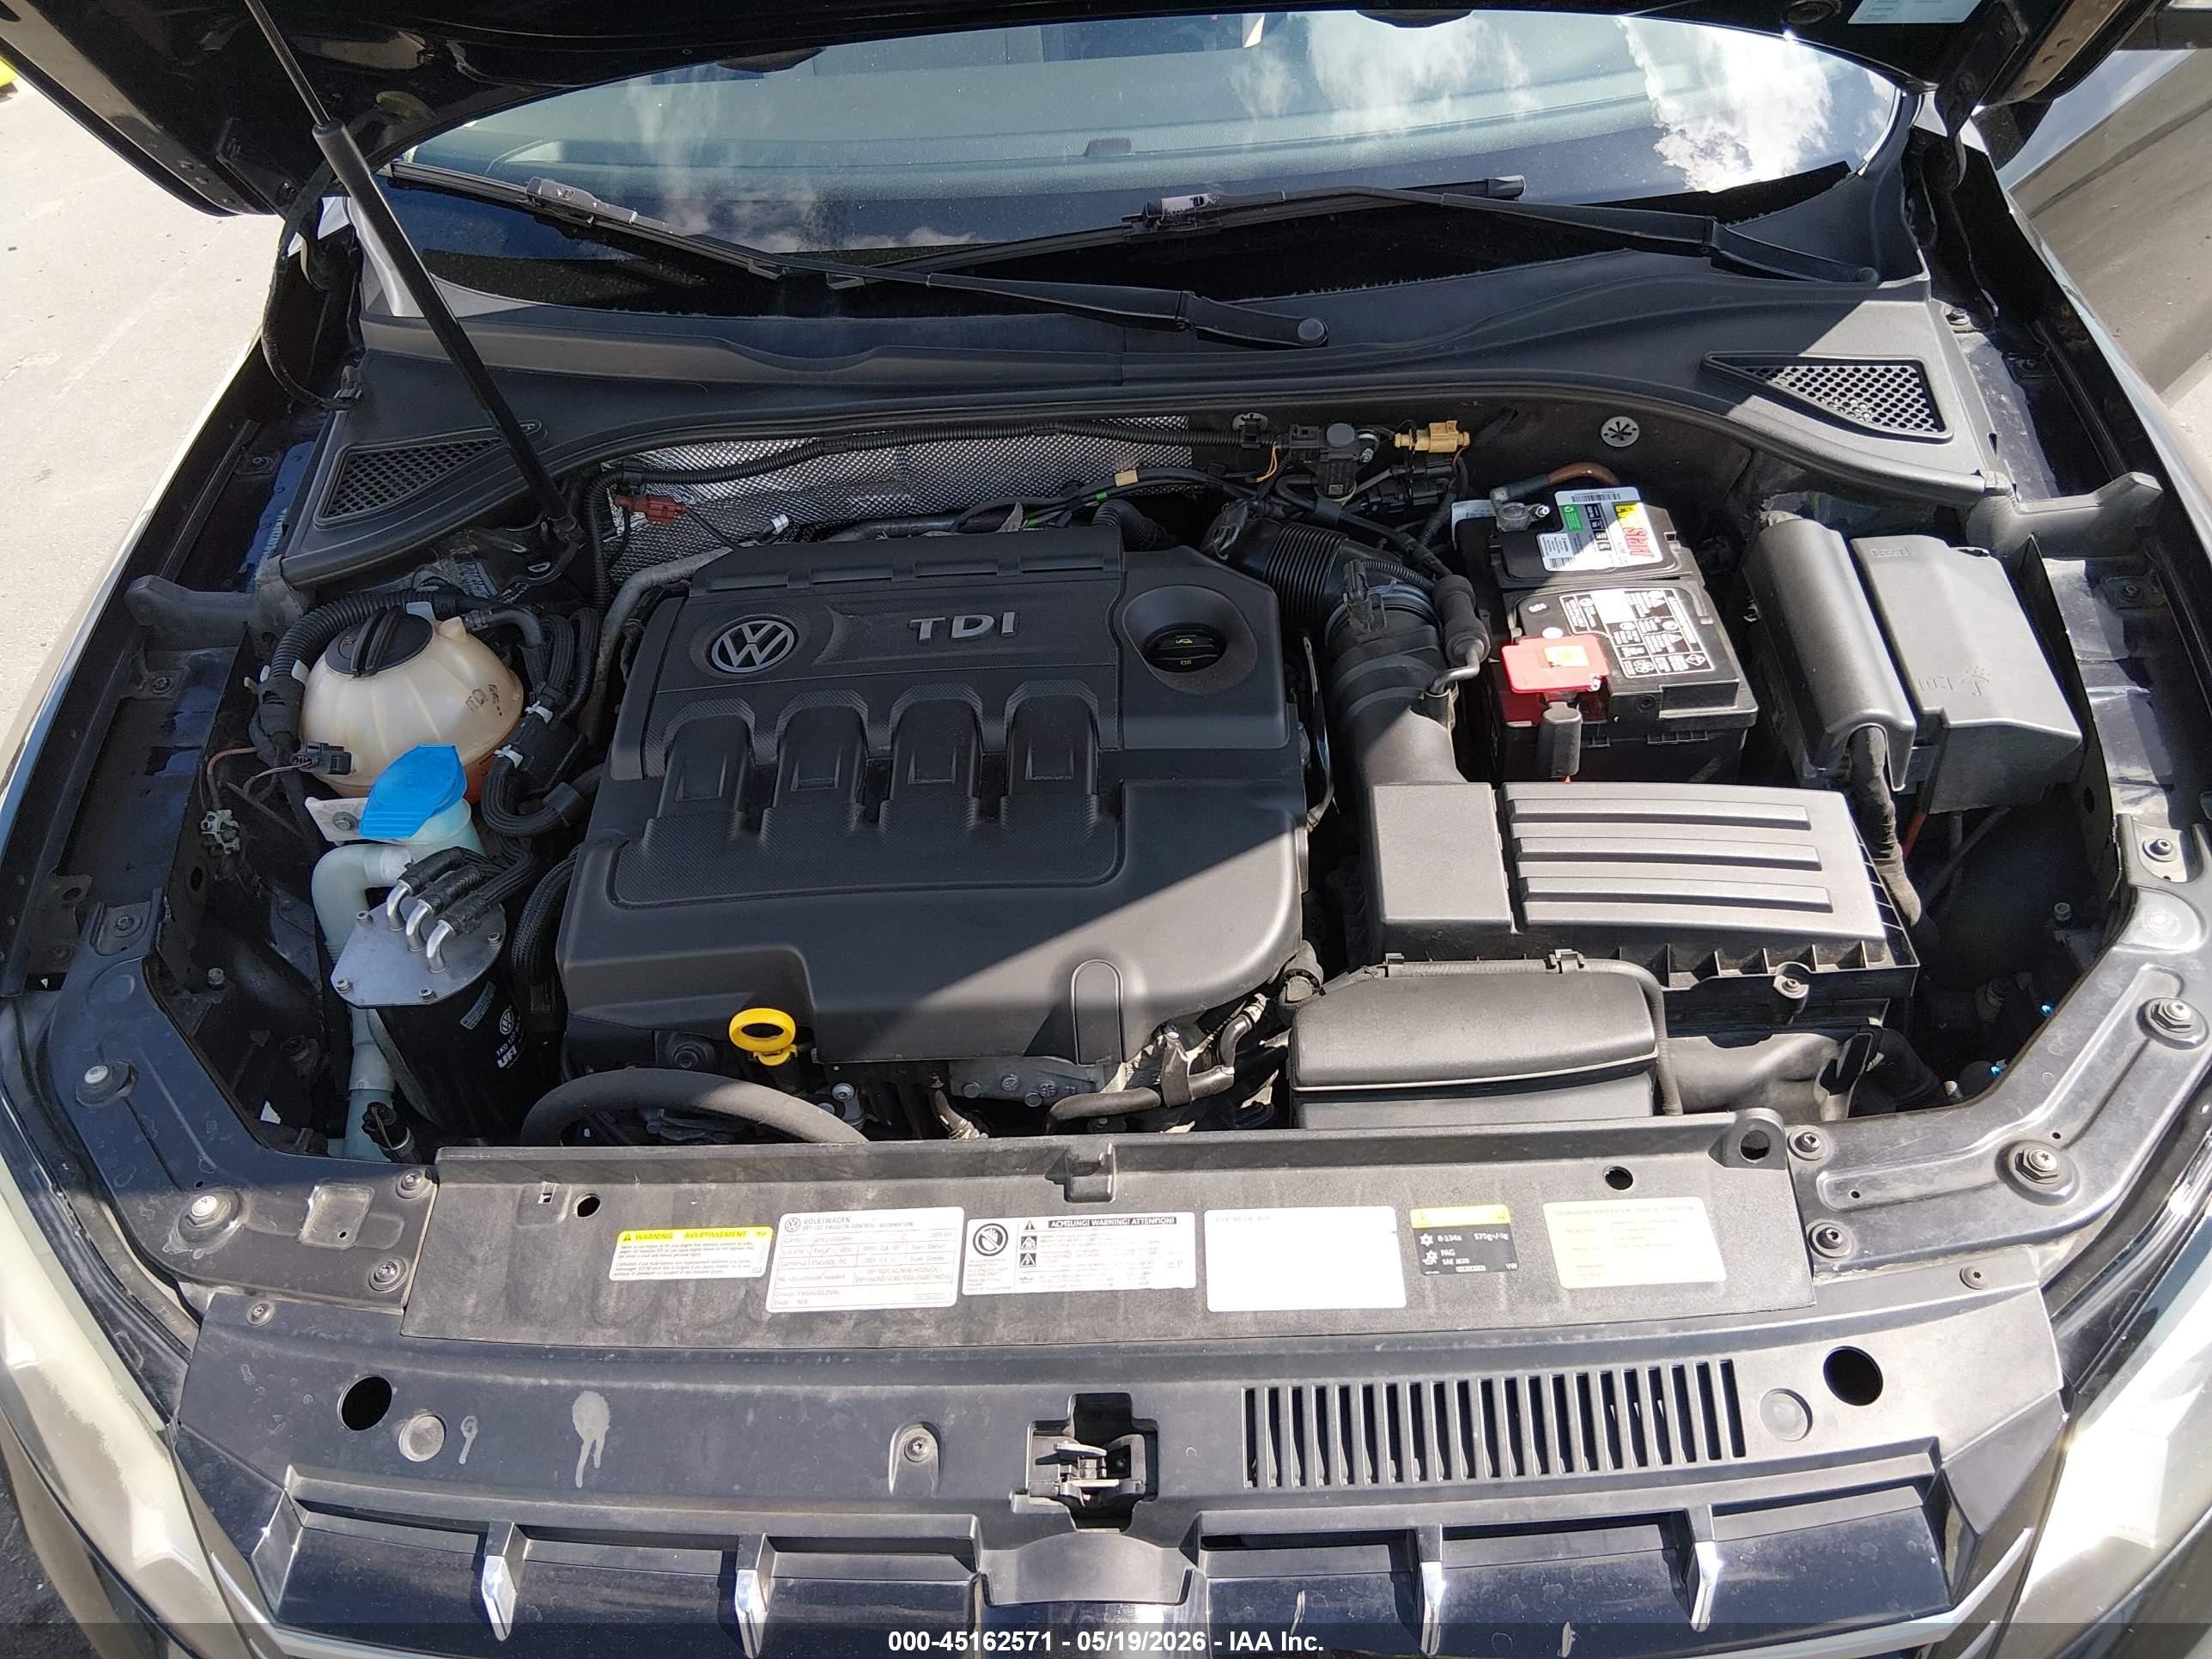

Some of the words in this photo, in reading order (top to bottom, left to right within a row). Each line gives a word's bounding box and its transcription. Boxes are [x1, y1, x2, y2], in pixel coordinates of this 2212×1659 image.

[908, 611, 1017, 643] TDI
[496, 1045, 517, 1068] UFI
[804, 1216, 851, 1224] VOLKSWAGEN
[1050, 1218, 1090, 1228] ACHTUNG!
[1091, 1218, 1130, 1227] WARNING!
[1131, 1217, 1175, 1226] ATTENTION!
[635, 1232, 673, 1241] WARNING
[684, 1231, 747, 1239] AVERTISSEMENT
[1440, 1249, 1456, 1257] PAG
